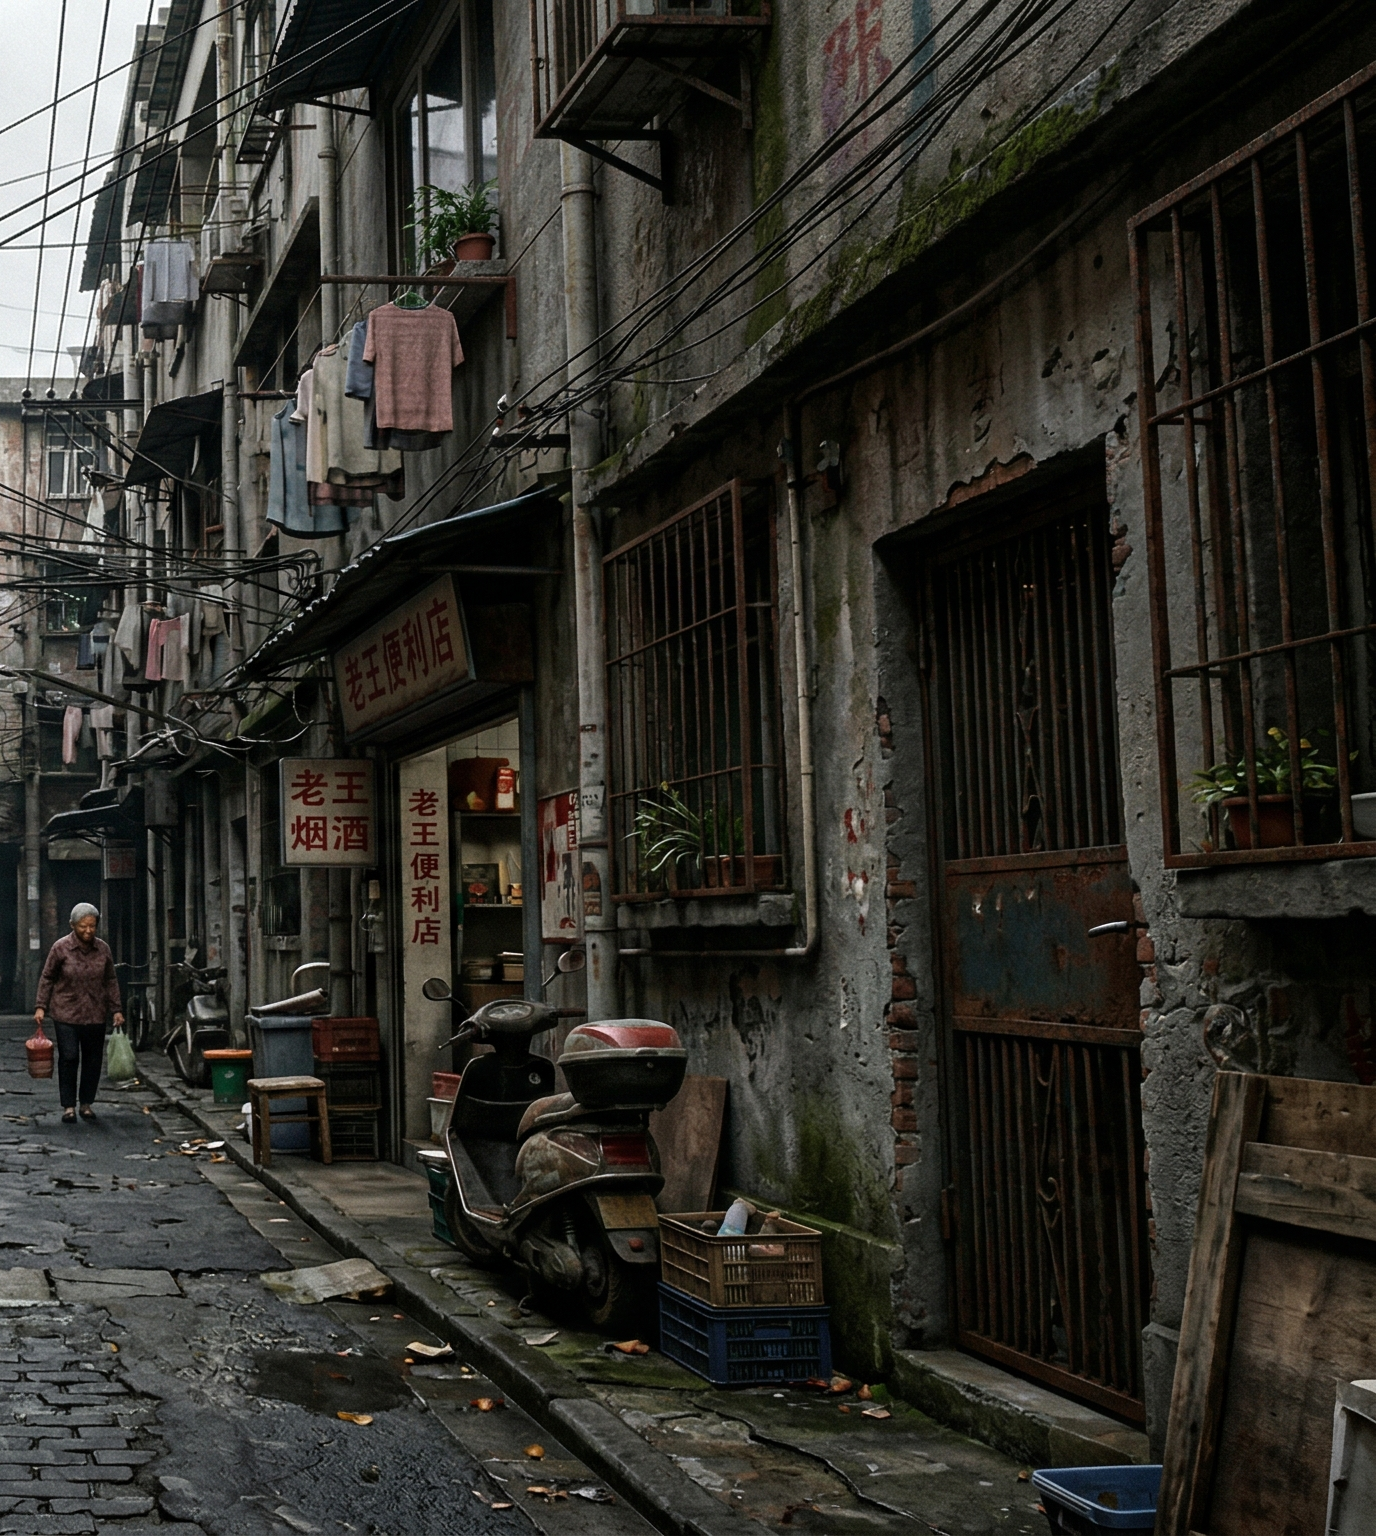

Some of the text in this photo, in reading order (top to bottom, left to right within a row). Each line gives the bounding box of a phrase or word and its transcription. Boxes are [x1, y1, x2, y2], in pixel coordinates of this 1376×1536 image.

[344, 597, 455, 712] 老王便利店
[290, 768, 369, 807] 老王
[290, 815, 369, 852] 烟酒
[408, 788, 442, 946] 老王便利店
